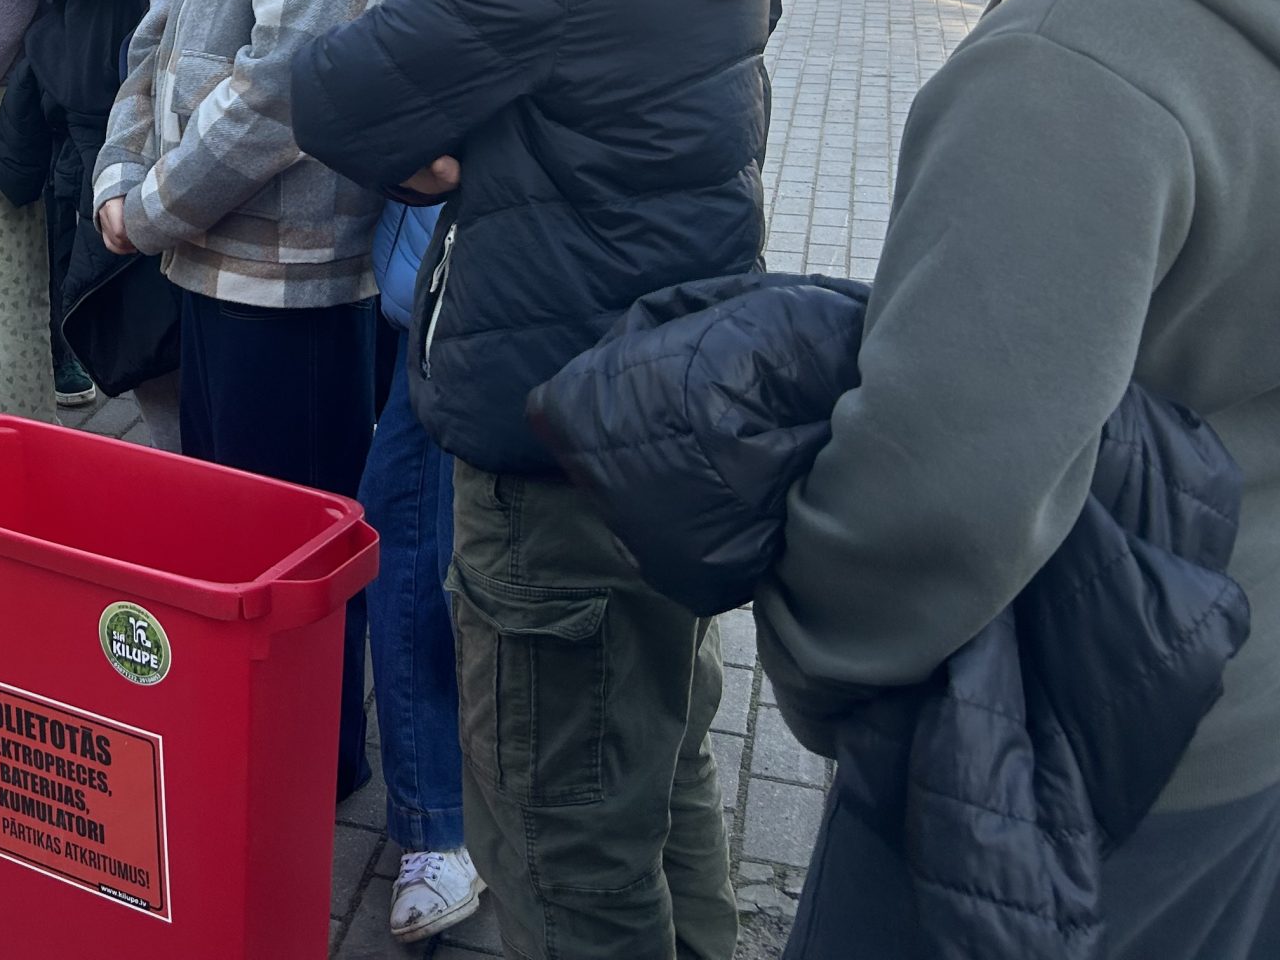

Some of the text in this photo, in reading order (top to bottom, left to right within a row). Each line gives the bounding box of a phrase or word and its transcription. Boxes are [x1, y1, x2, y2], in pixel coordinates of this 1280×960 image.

[113, 630, 125, 643] SIA
[0, 762, 90, 814] BATERIJAS,
[3, 817, 61, 856] PĀRTIKAS
[65, 834, 150, 889] ATKRITUMUS!
[100, 885, 147, 907] www.kilupe.lv
